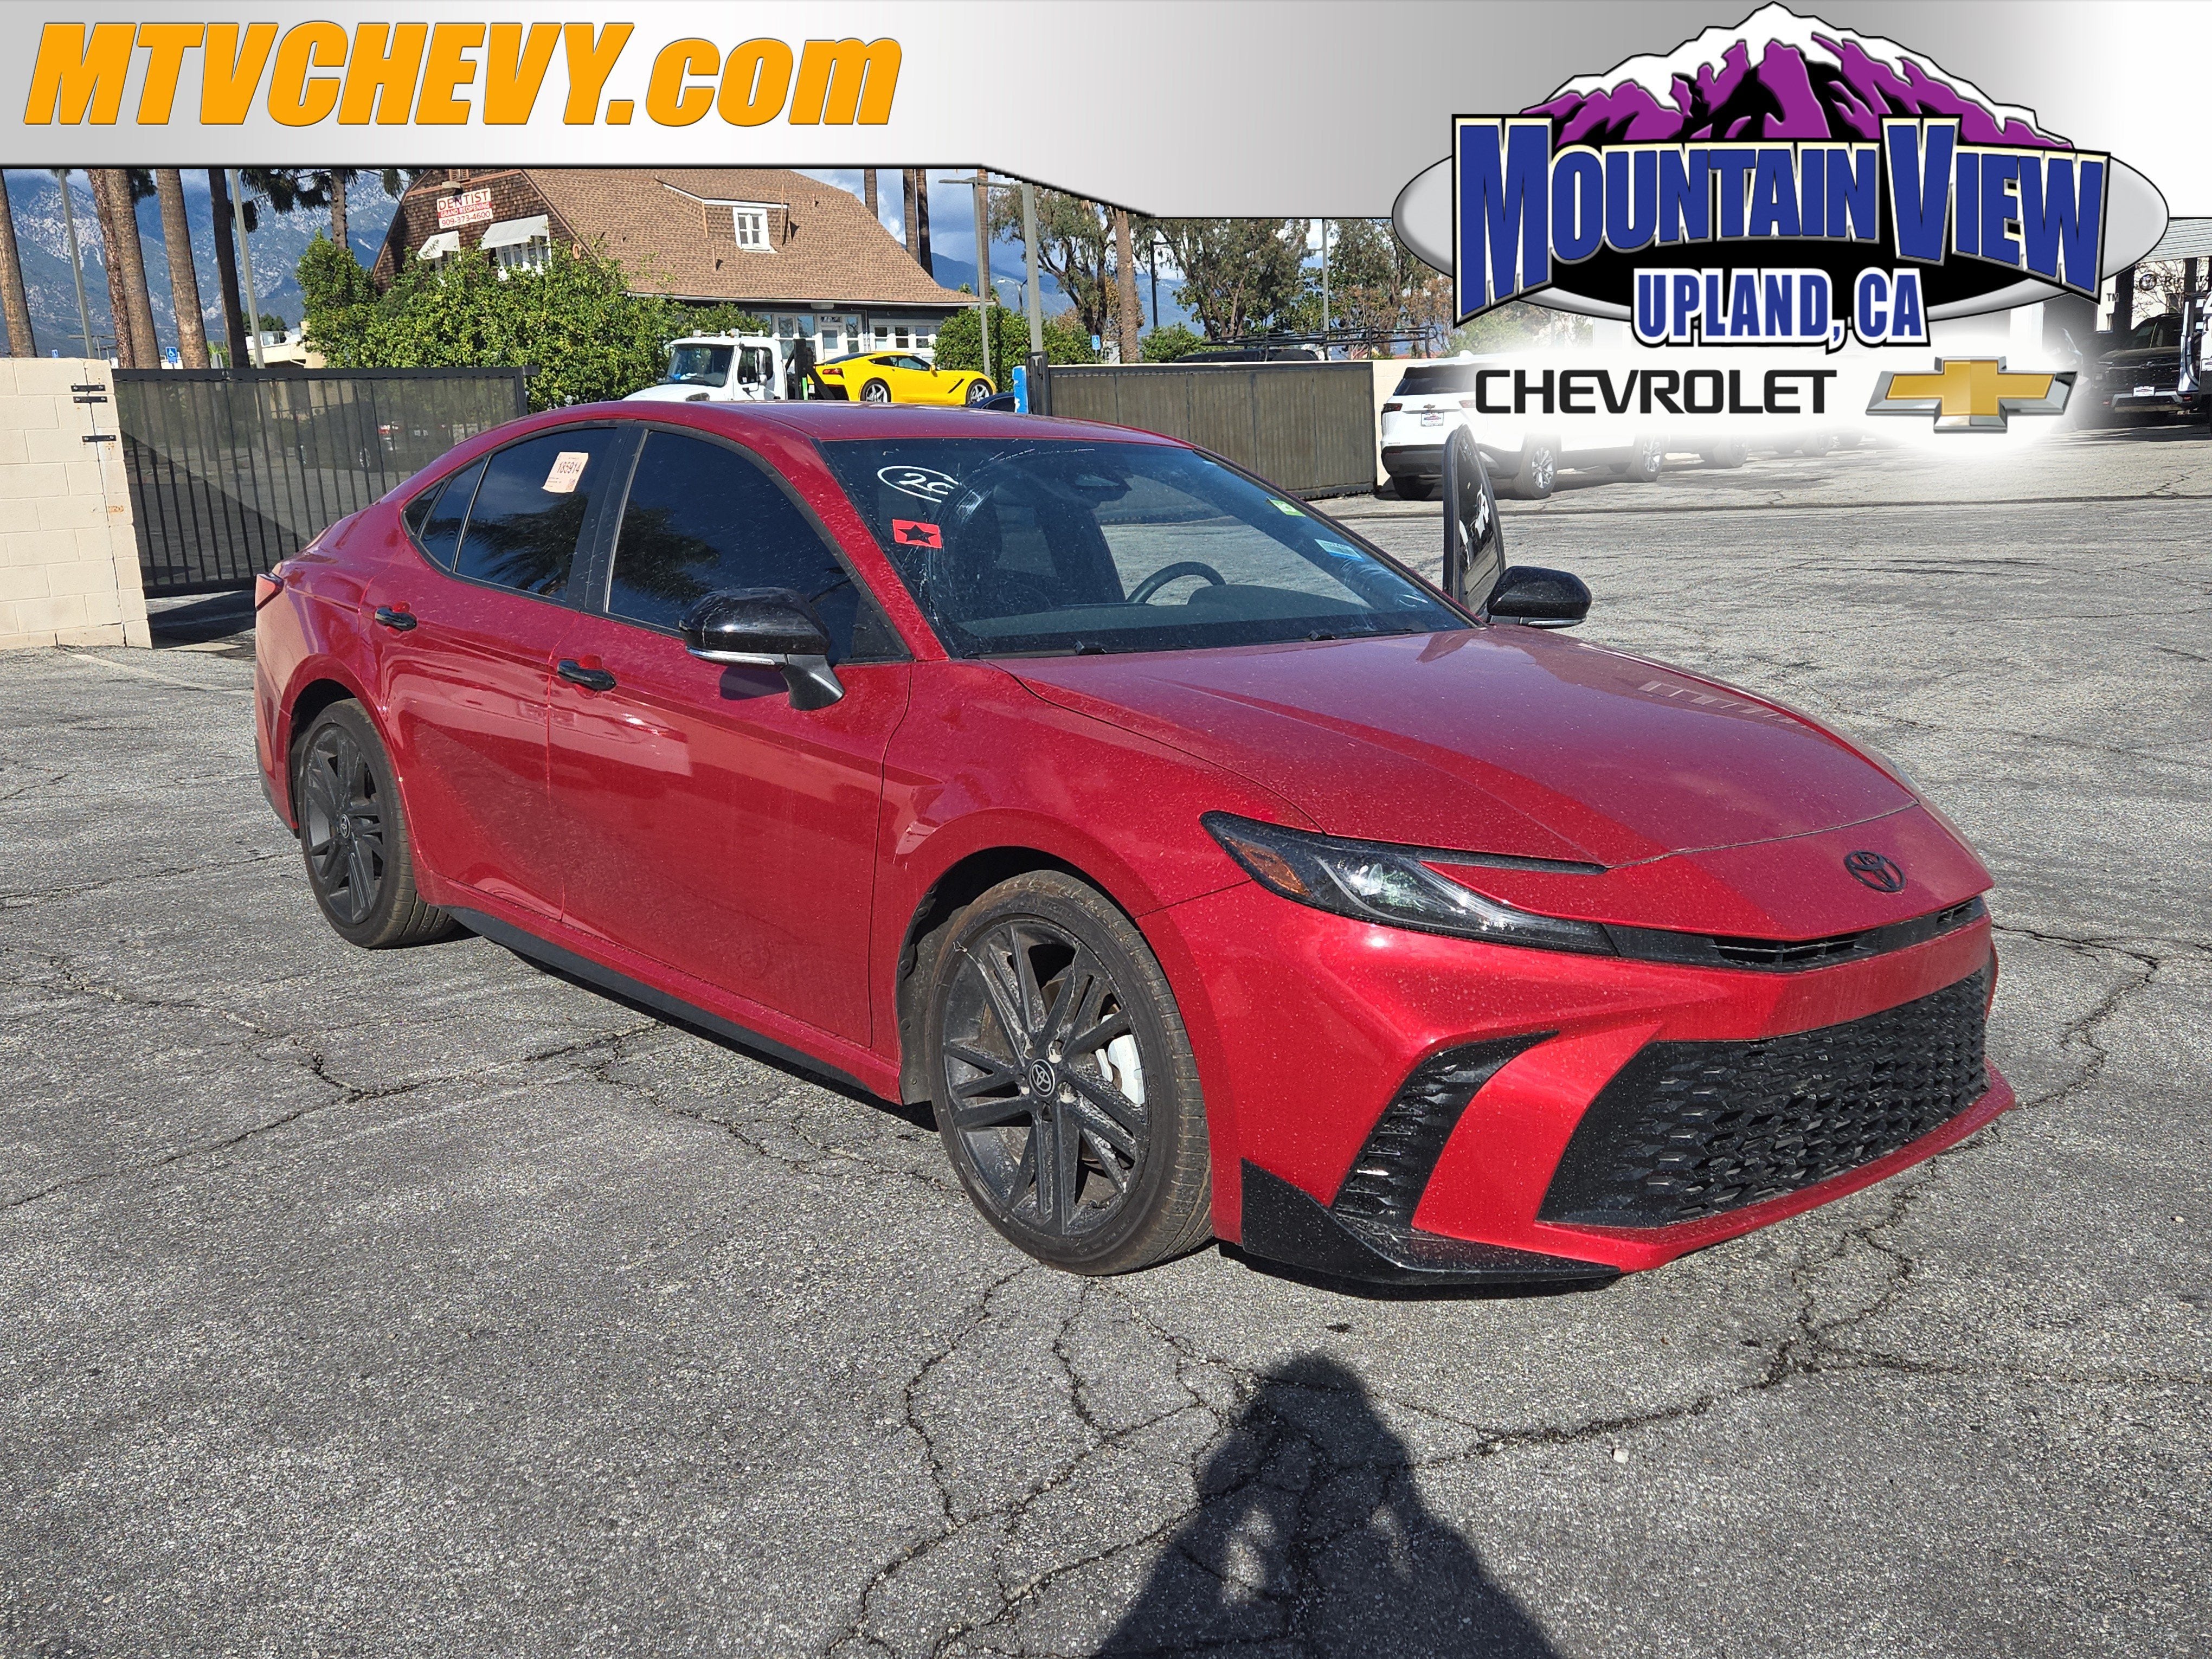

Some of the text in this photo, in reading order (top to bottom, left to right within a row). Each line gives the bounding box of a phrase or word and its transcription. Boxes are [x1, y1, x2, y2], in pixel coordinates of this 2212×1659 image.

[439, 190, 488, 210] DENTIST
[440, 202, 490, 218] GRAND REOPENING
[441, 210, 491, 227] 909-373-4600
